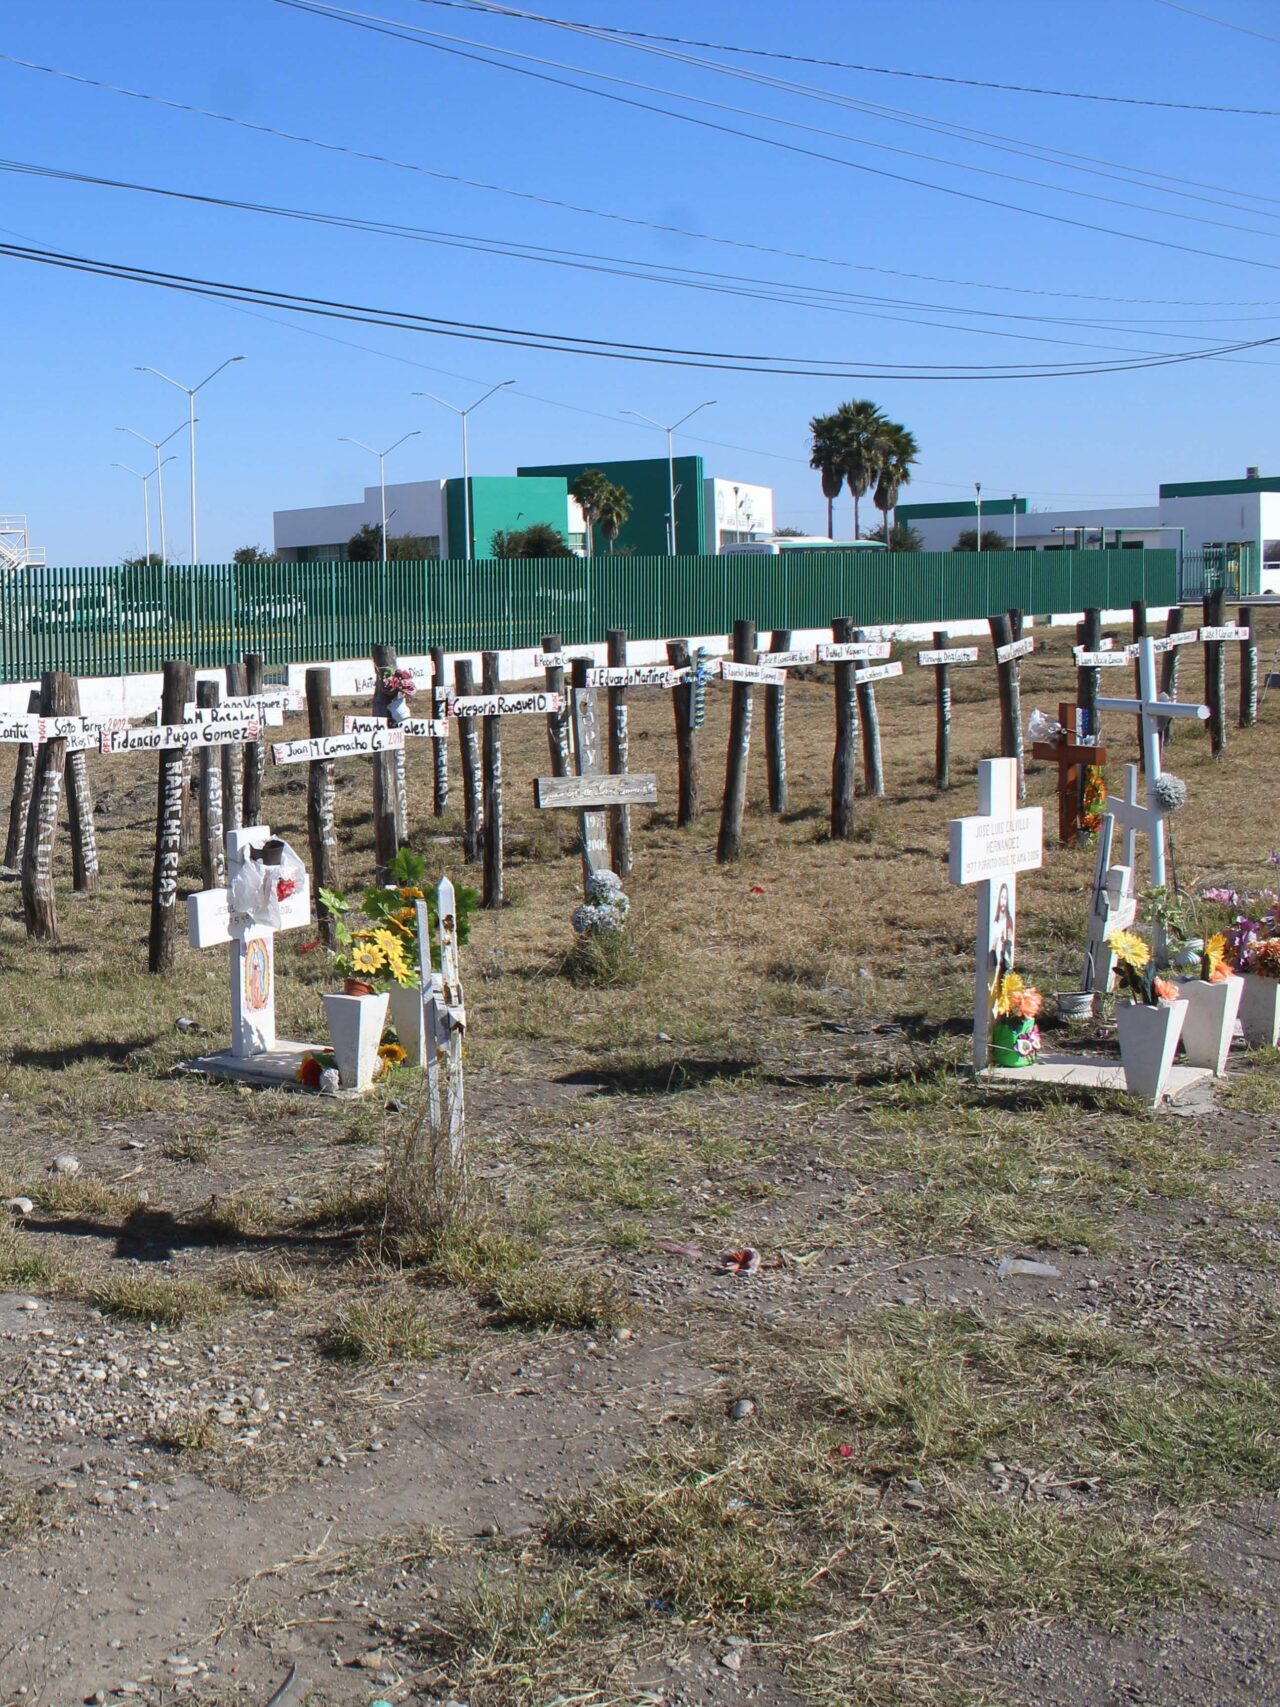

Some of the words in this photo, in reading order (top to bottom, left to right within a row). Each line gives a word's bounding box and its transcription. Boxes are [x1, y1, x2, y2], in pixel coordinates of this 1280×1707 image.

[453, 697, 496, 716] Gregorio
[111, 729, 161, 752] Fidencio
[166, 726, 198, 748] Puga
[323, 735, 368, 757] Camacho
